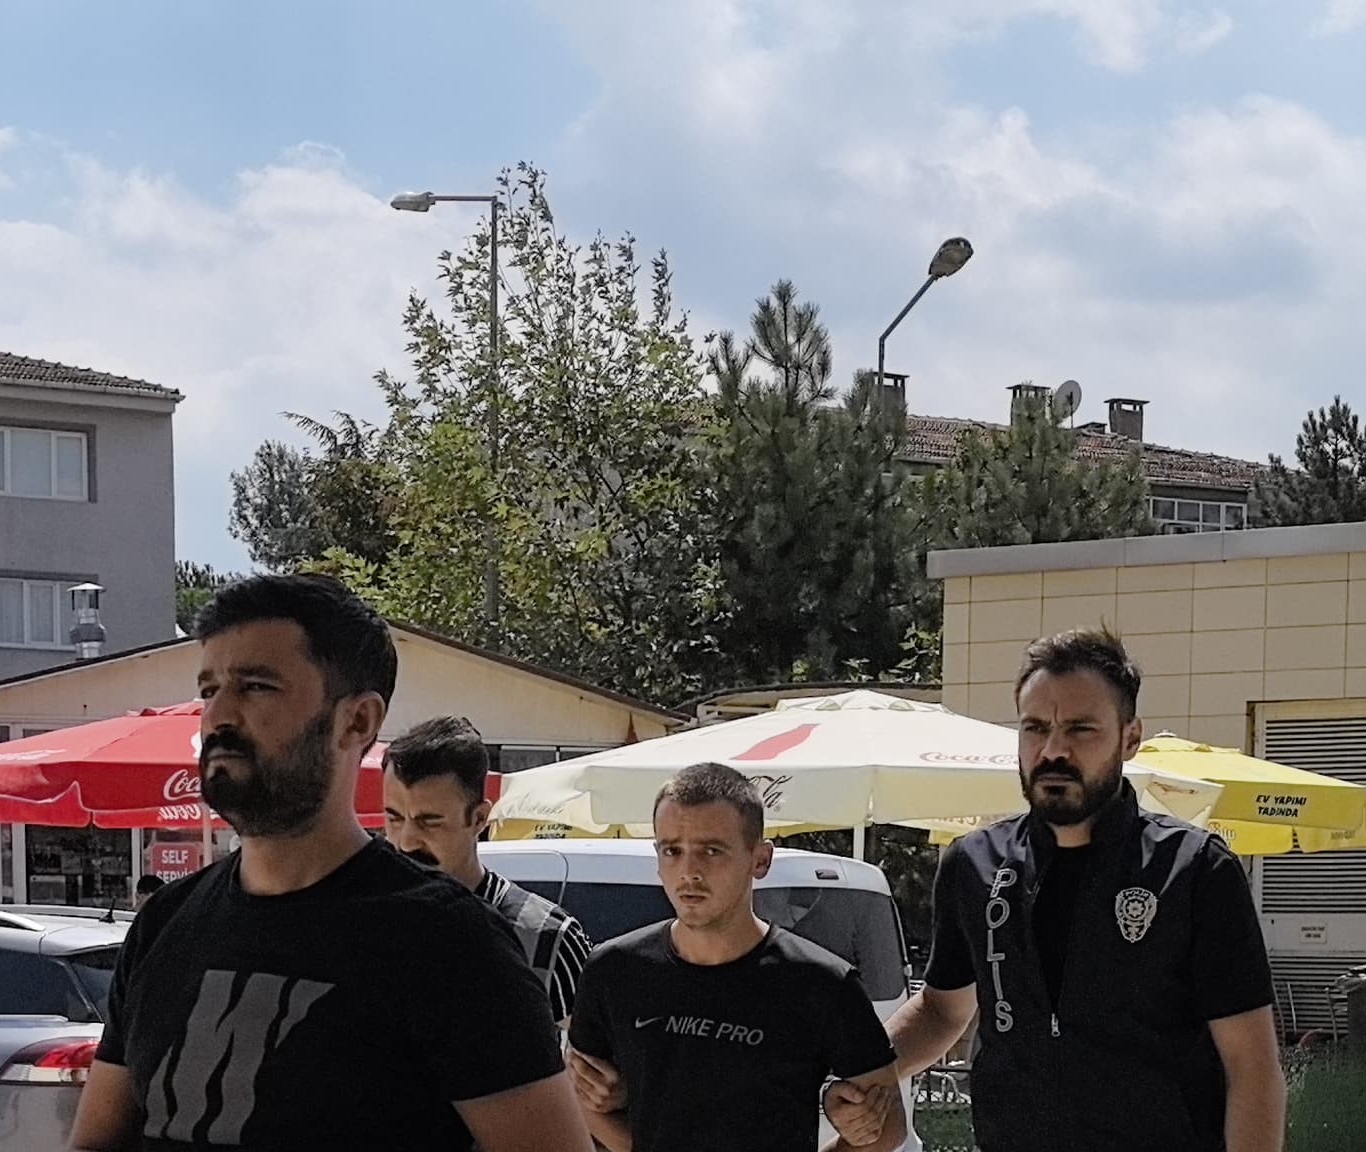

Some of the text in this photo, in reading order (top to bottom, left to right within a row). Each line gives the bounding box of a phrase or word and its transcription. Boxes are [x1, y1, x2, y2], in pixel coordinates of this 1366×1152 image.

[1255, 794, 1307, 806] EV YAPIMI
[1257, 807, 1299, 818] TADINDA
[161, 850, 189, 864] SELF
[665, 1016, 764, 1045] NIKE PRO
